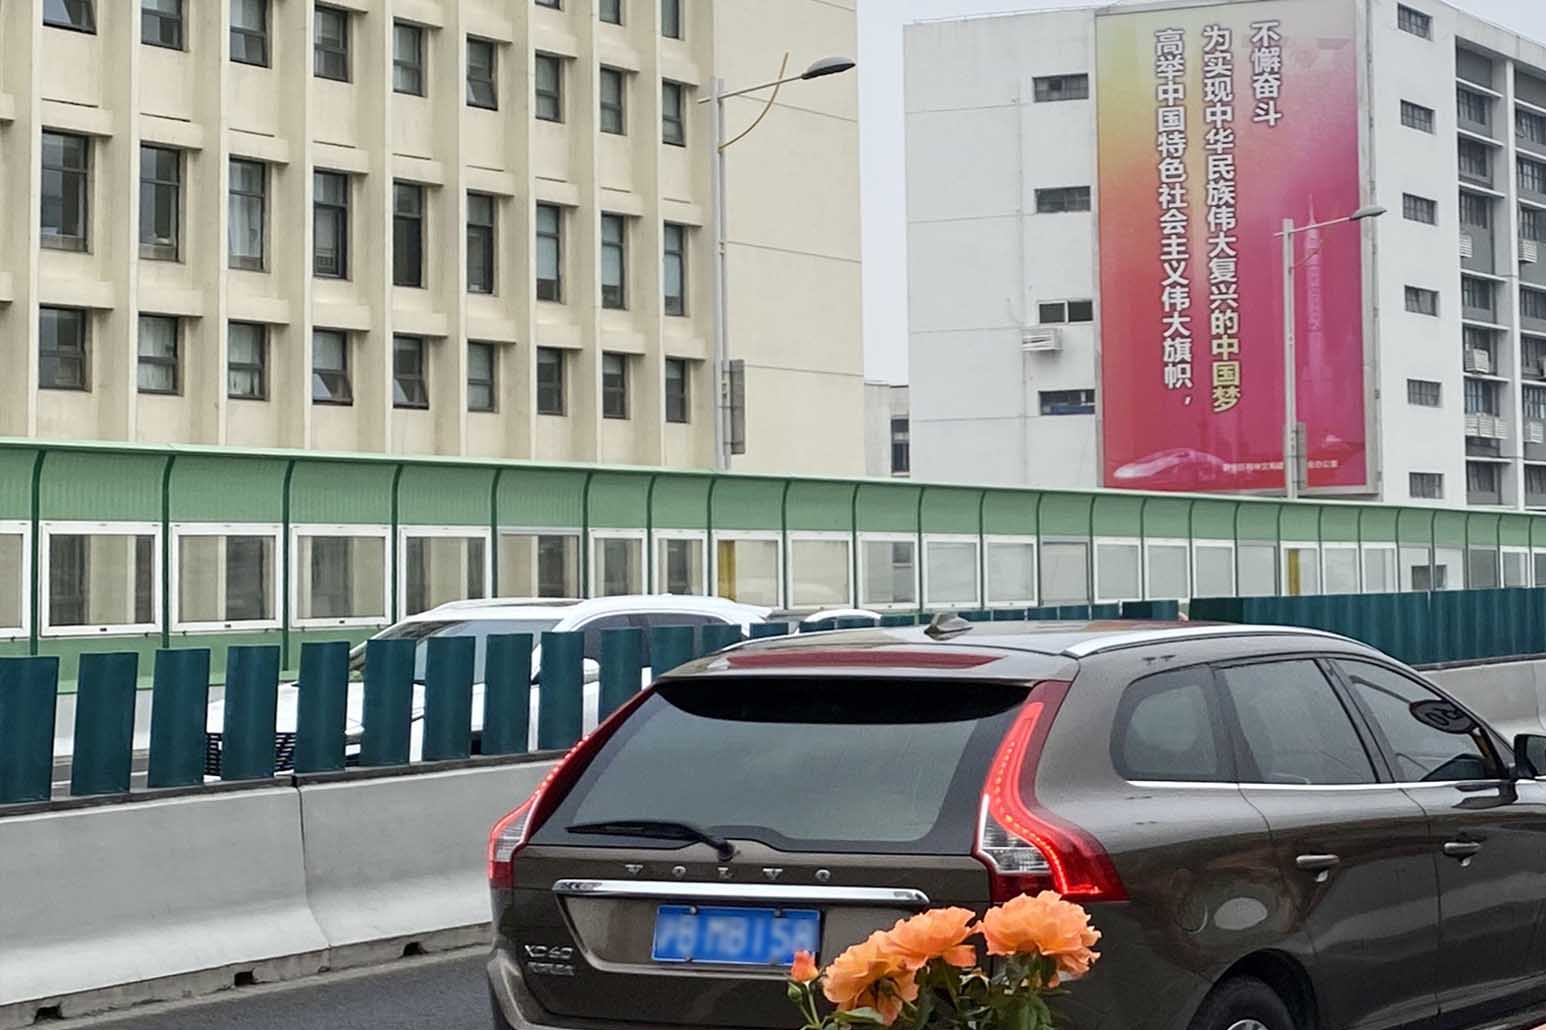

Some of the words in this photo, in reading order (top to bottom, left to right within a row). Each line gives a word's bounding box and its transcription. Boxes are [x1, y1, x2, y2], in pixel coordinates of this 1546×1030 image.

[1250, 20, 1282, 126] 不懈奋斗
[1155, 28, 1193, 405] 高举中国特色社会主义伟大旗帜，
[1202, 25, 1241, 413] 为实现中华民族伟大复兴的中国梦
[624, 863, 832, 882] VOLVO
